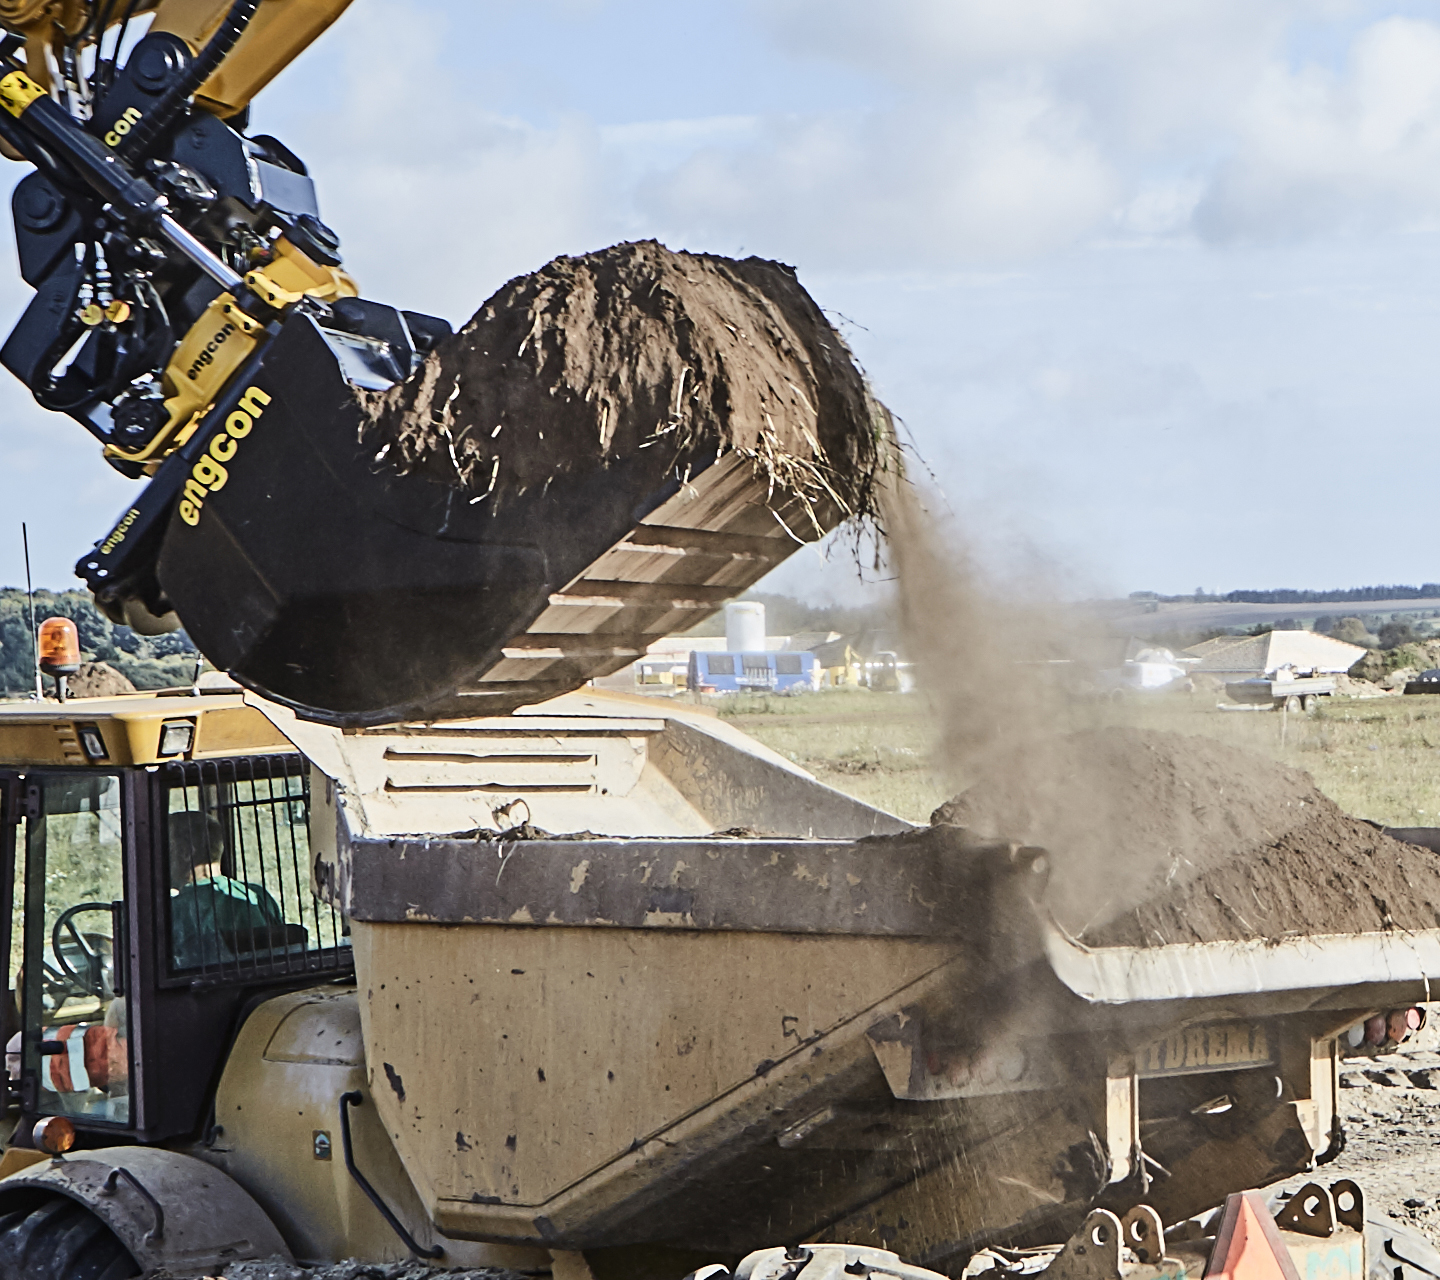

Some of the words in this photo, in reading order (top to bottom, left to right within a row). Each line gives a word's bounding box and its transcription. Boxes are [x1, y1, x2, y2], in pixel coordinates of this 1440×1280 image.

[104, 106, 143, 147] con
[187, 323, 235, 380] engcon
[179, 386, 272, 526] engcon
[100, 508, 140, 554] engcon
